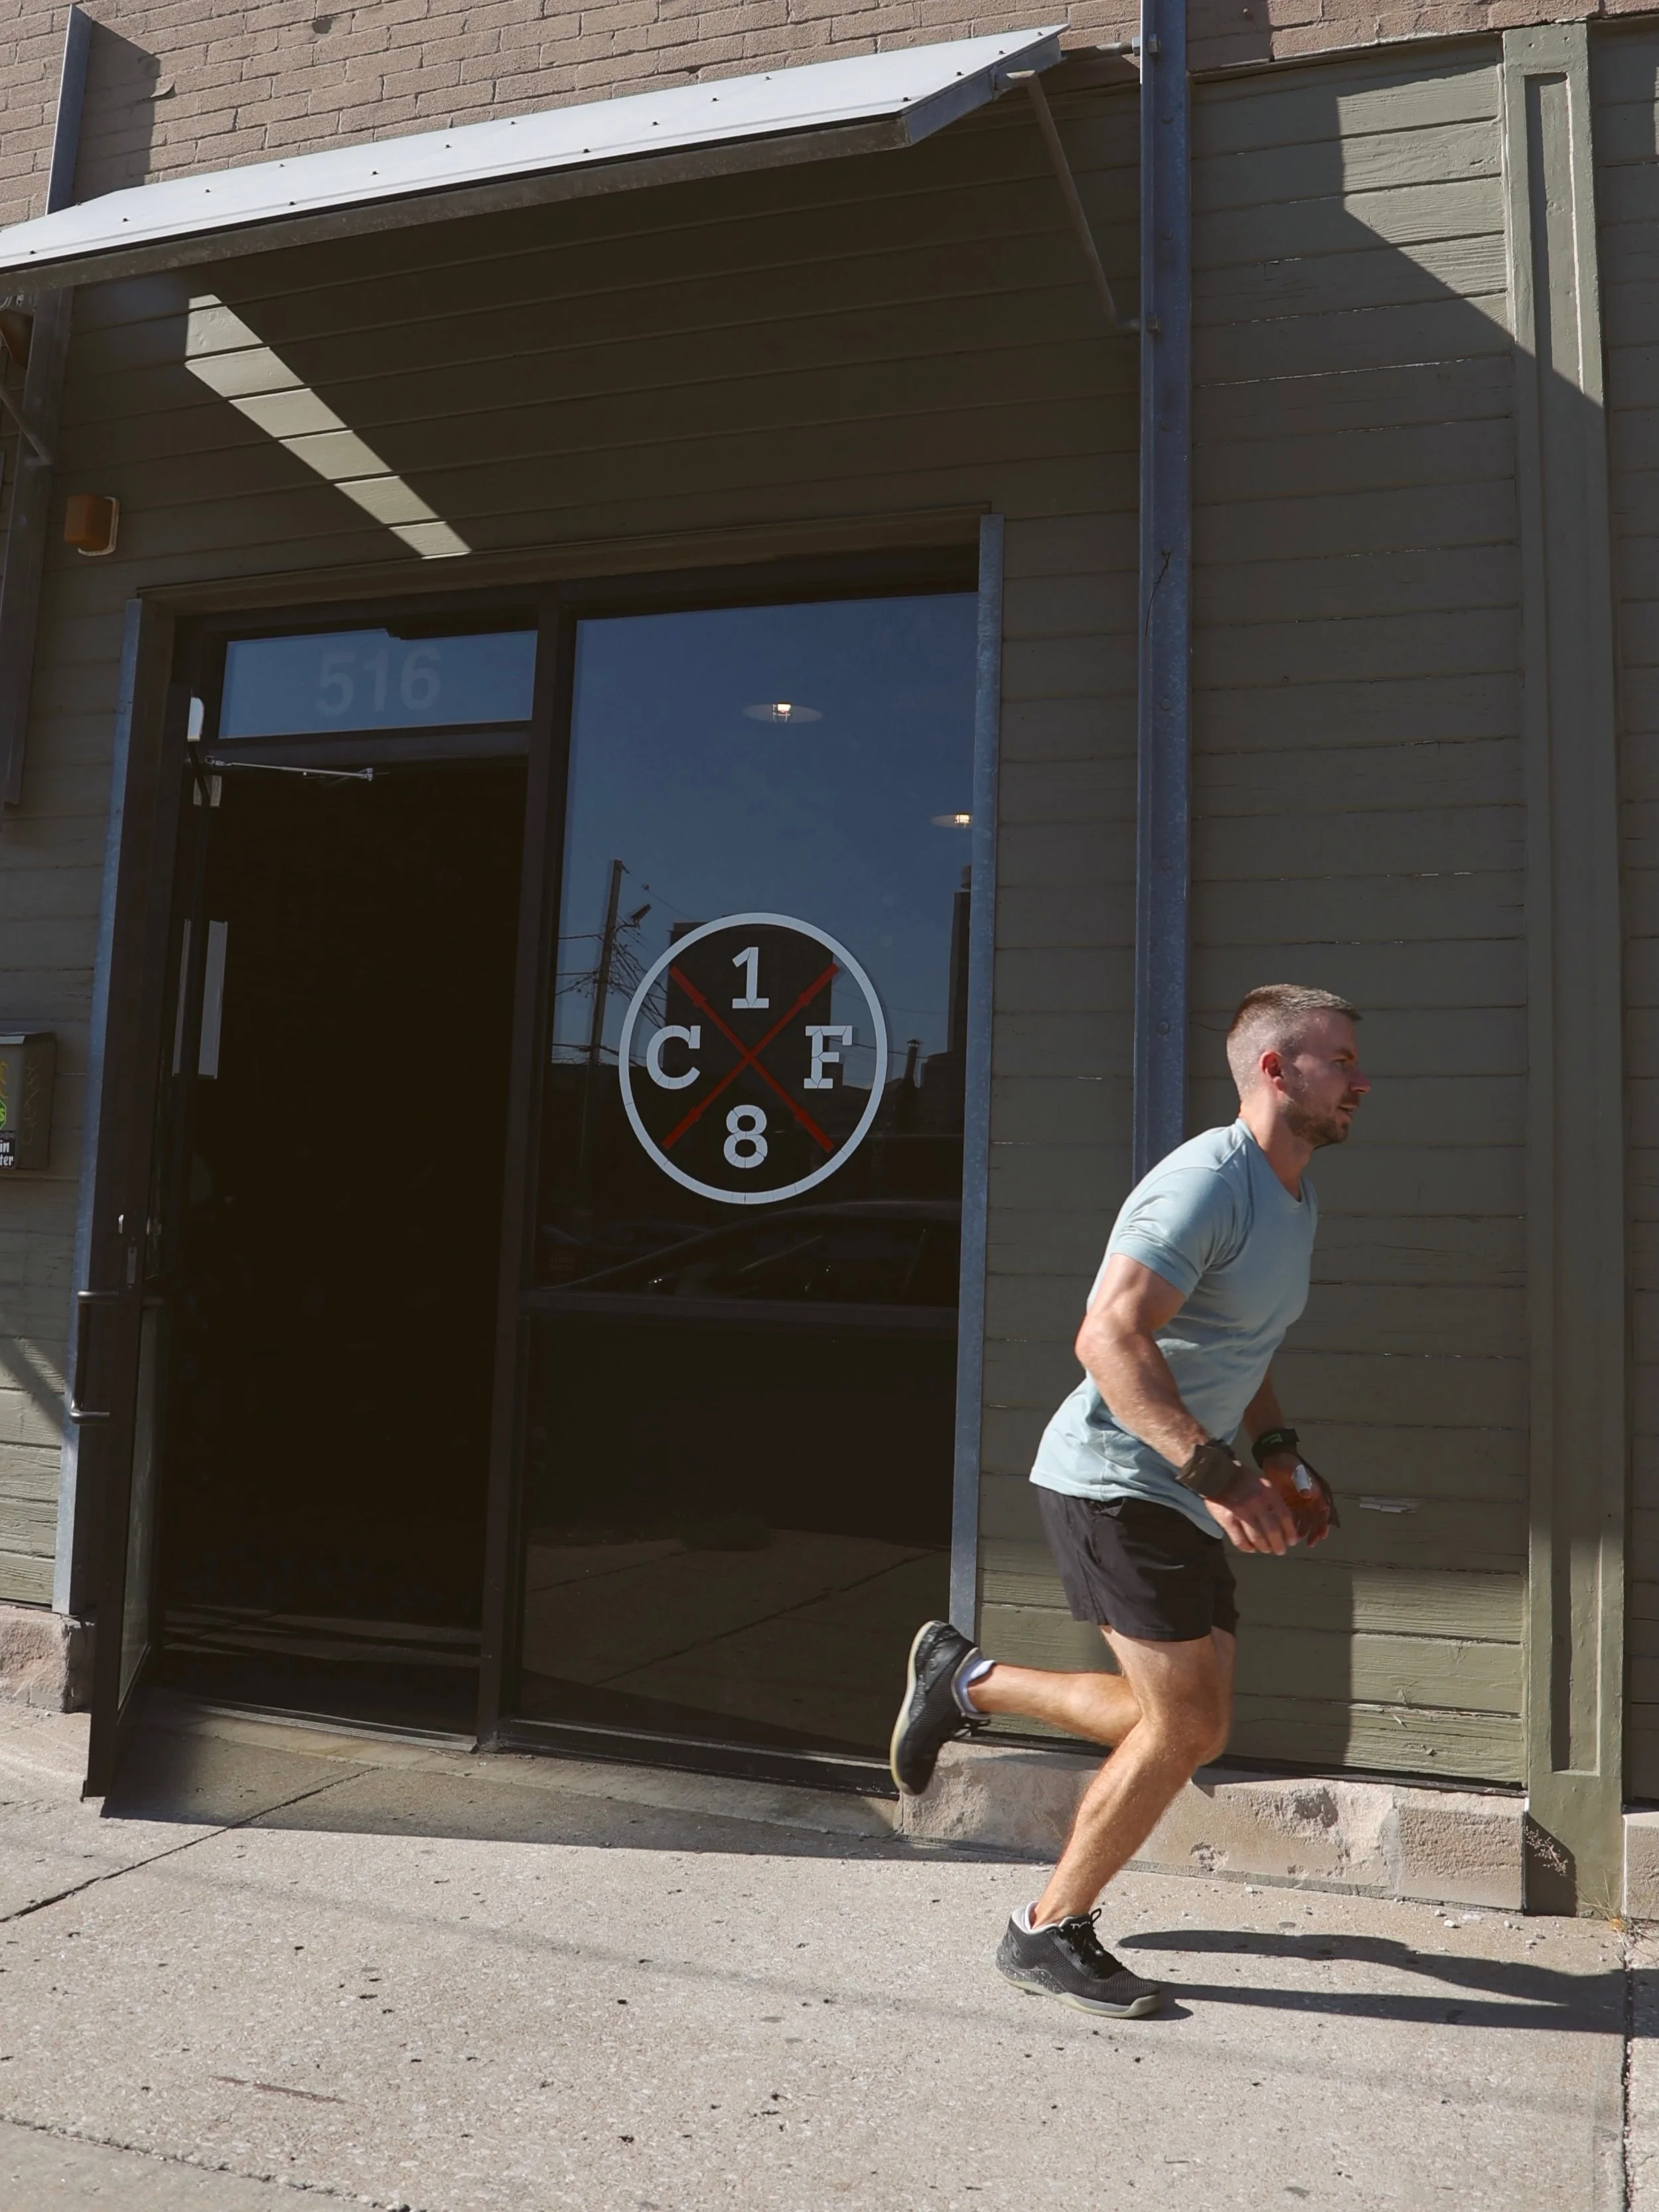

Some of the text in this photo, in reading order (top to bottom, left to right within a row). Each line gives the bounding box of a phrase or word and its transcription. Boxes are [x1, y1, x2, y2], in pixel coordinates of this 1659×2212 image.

[315, 645, 441, 719] 516
[732, 946, 769, 1009] 1
[646, 1025, 853, 1090] C F
[723, 1104, 768, 1169] 8
